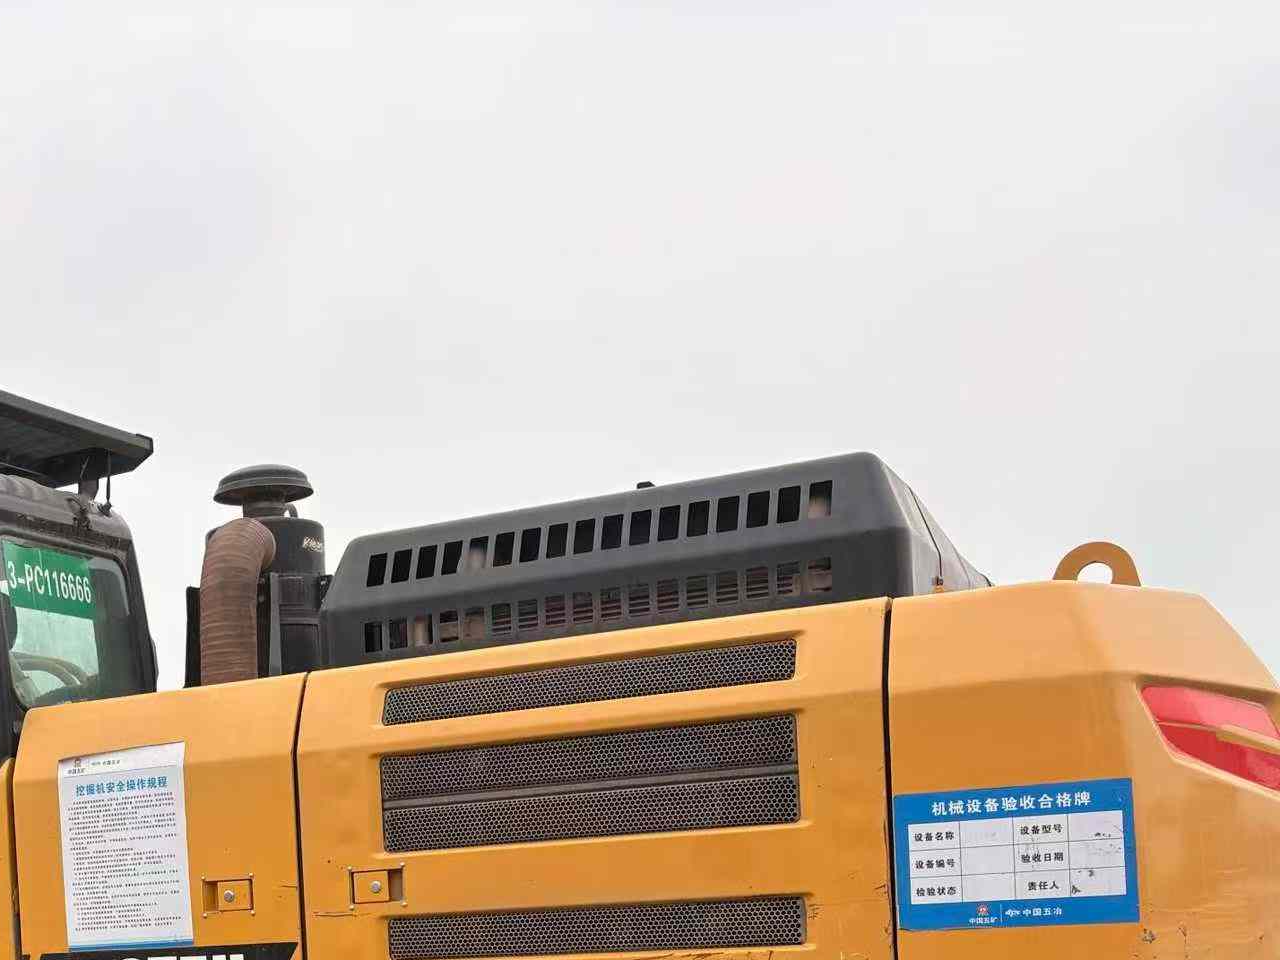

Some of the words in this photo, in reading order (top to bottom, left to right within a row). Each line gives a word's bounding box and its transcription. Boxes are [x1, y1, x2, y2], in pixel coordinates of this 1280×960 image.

[75, 776, 168, 797] 挖掘机安全操作规程
[931, 791, 1092, 816] 机械设备验收合格牌
[1020, 823, 1063, 836] 设备型号
[914, 831, 955, 842] 设备名称
[915, 858, 956, 870] 设备编号
[1020, 852, 1064, 864] 验收日期
[916, 886, 957, 897] 检验状态
[1027, 880, 1060, 892] 责任人
